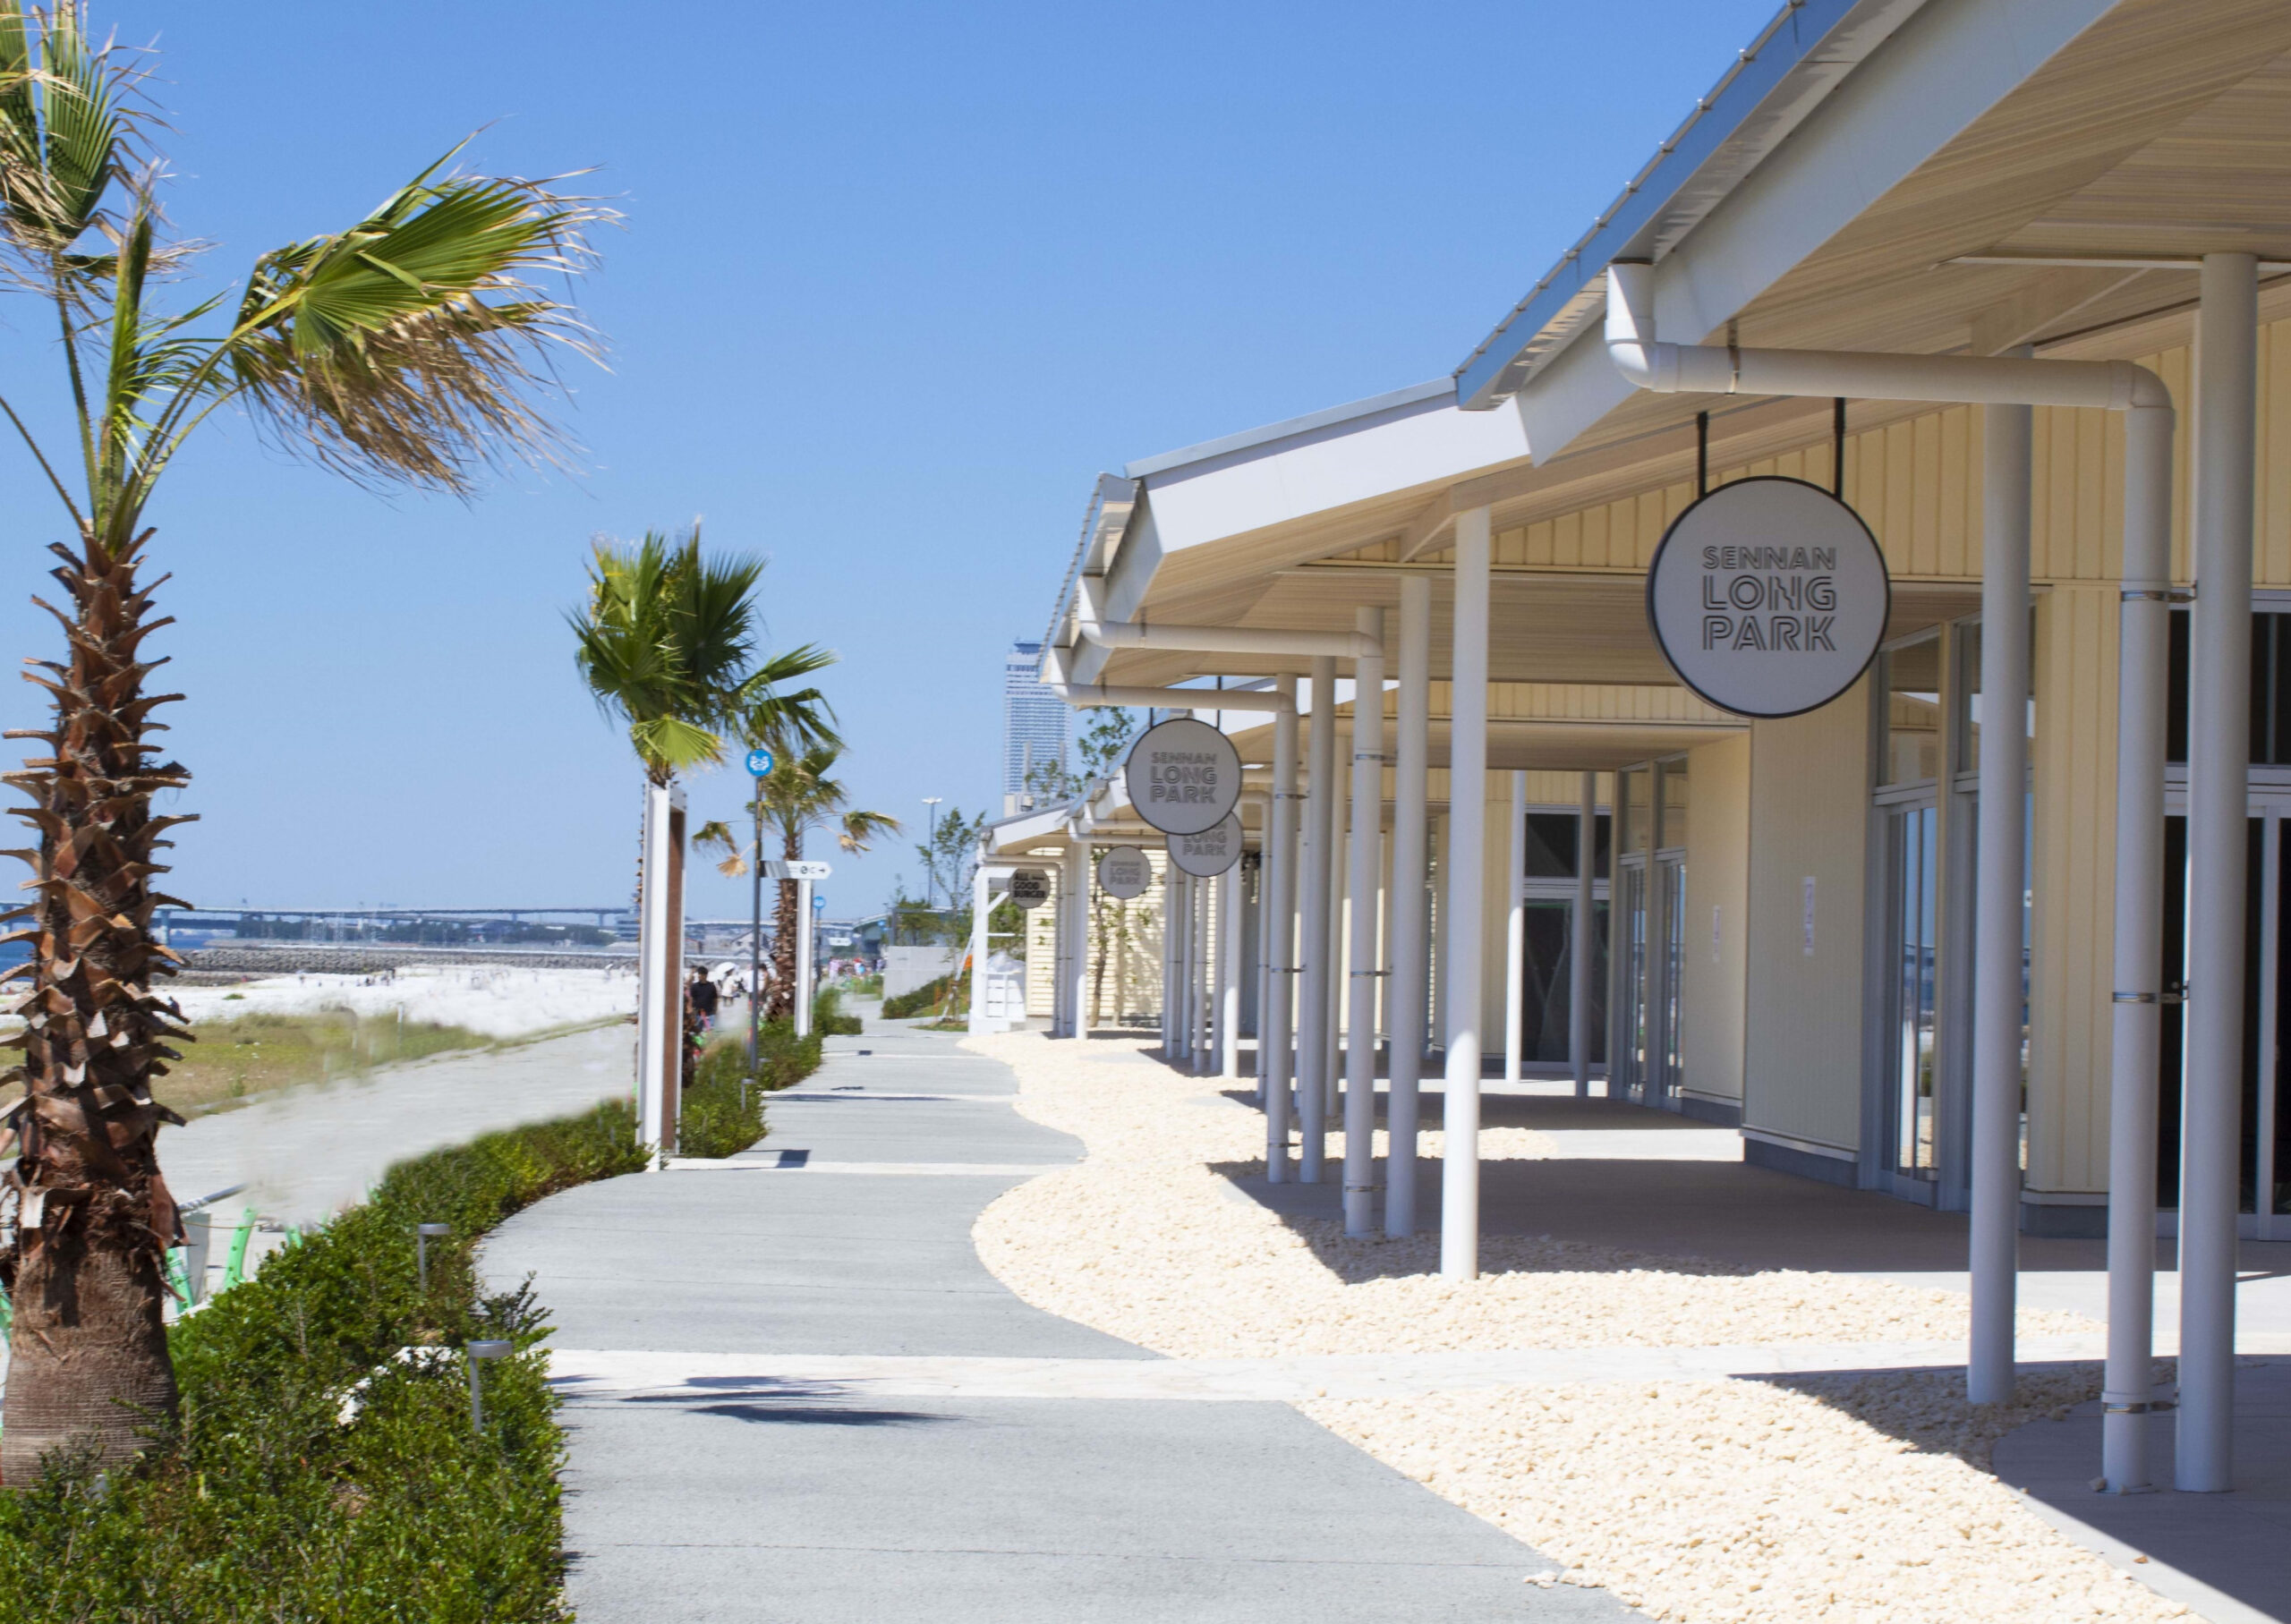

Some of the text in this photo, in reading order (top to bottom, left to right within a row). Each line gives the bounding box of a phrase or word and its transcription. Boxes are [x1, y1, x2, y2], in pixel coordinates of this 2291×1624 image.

[1702, 546, 1836, 570] SENNAN
[1702, 575, 1836, 611] LONG
[1702, 615, 1836, 651] PARK
[1151, 752, 1217, 764] SENNAN
[1150, 766, 1217, 785] LONG
[1150, 786, 1217, 803] PARK
[1182, 844, 1227, 855] PARK
